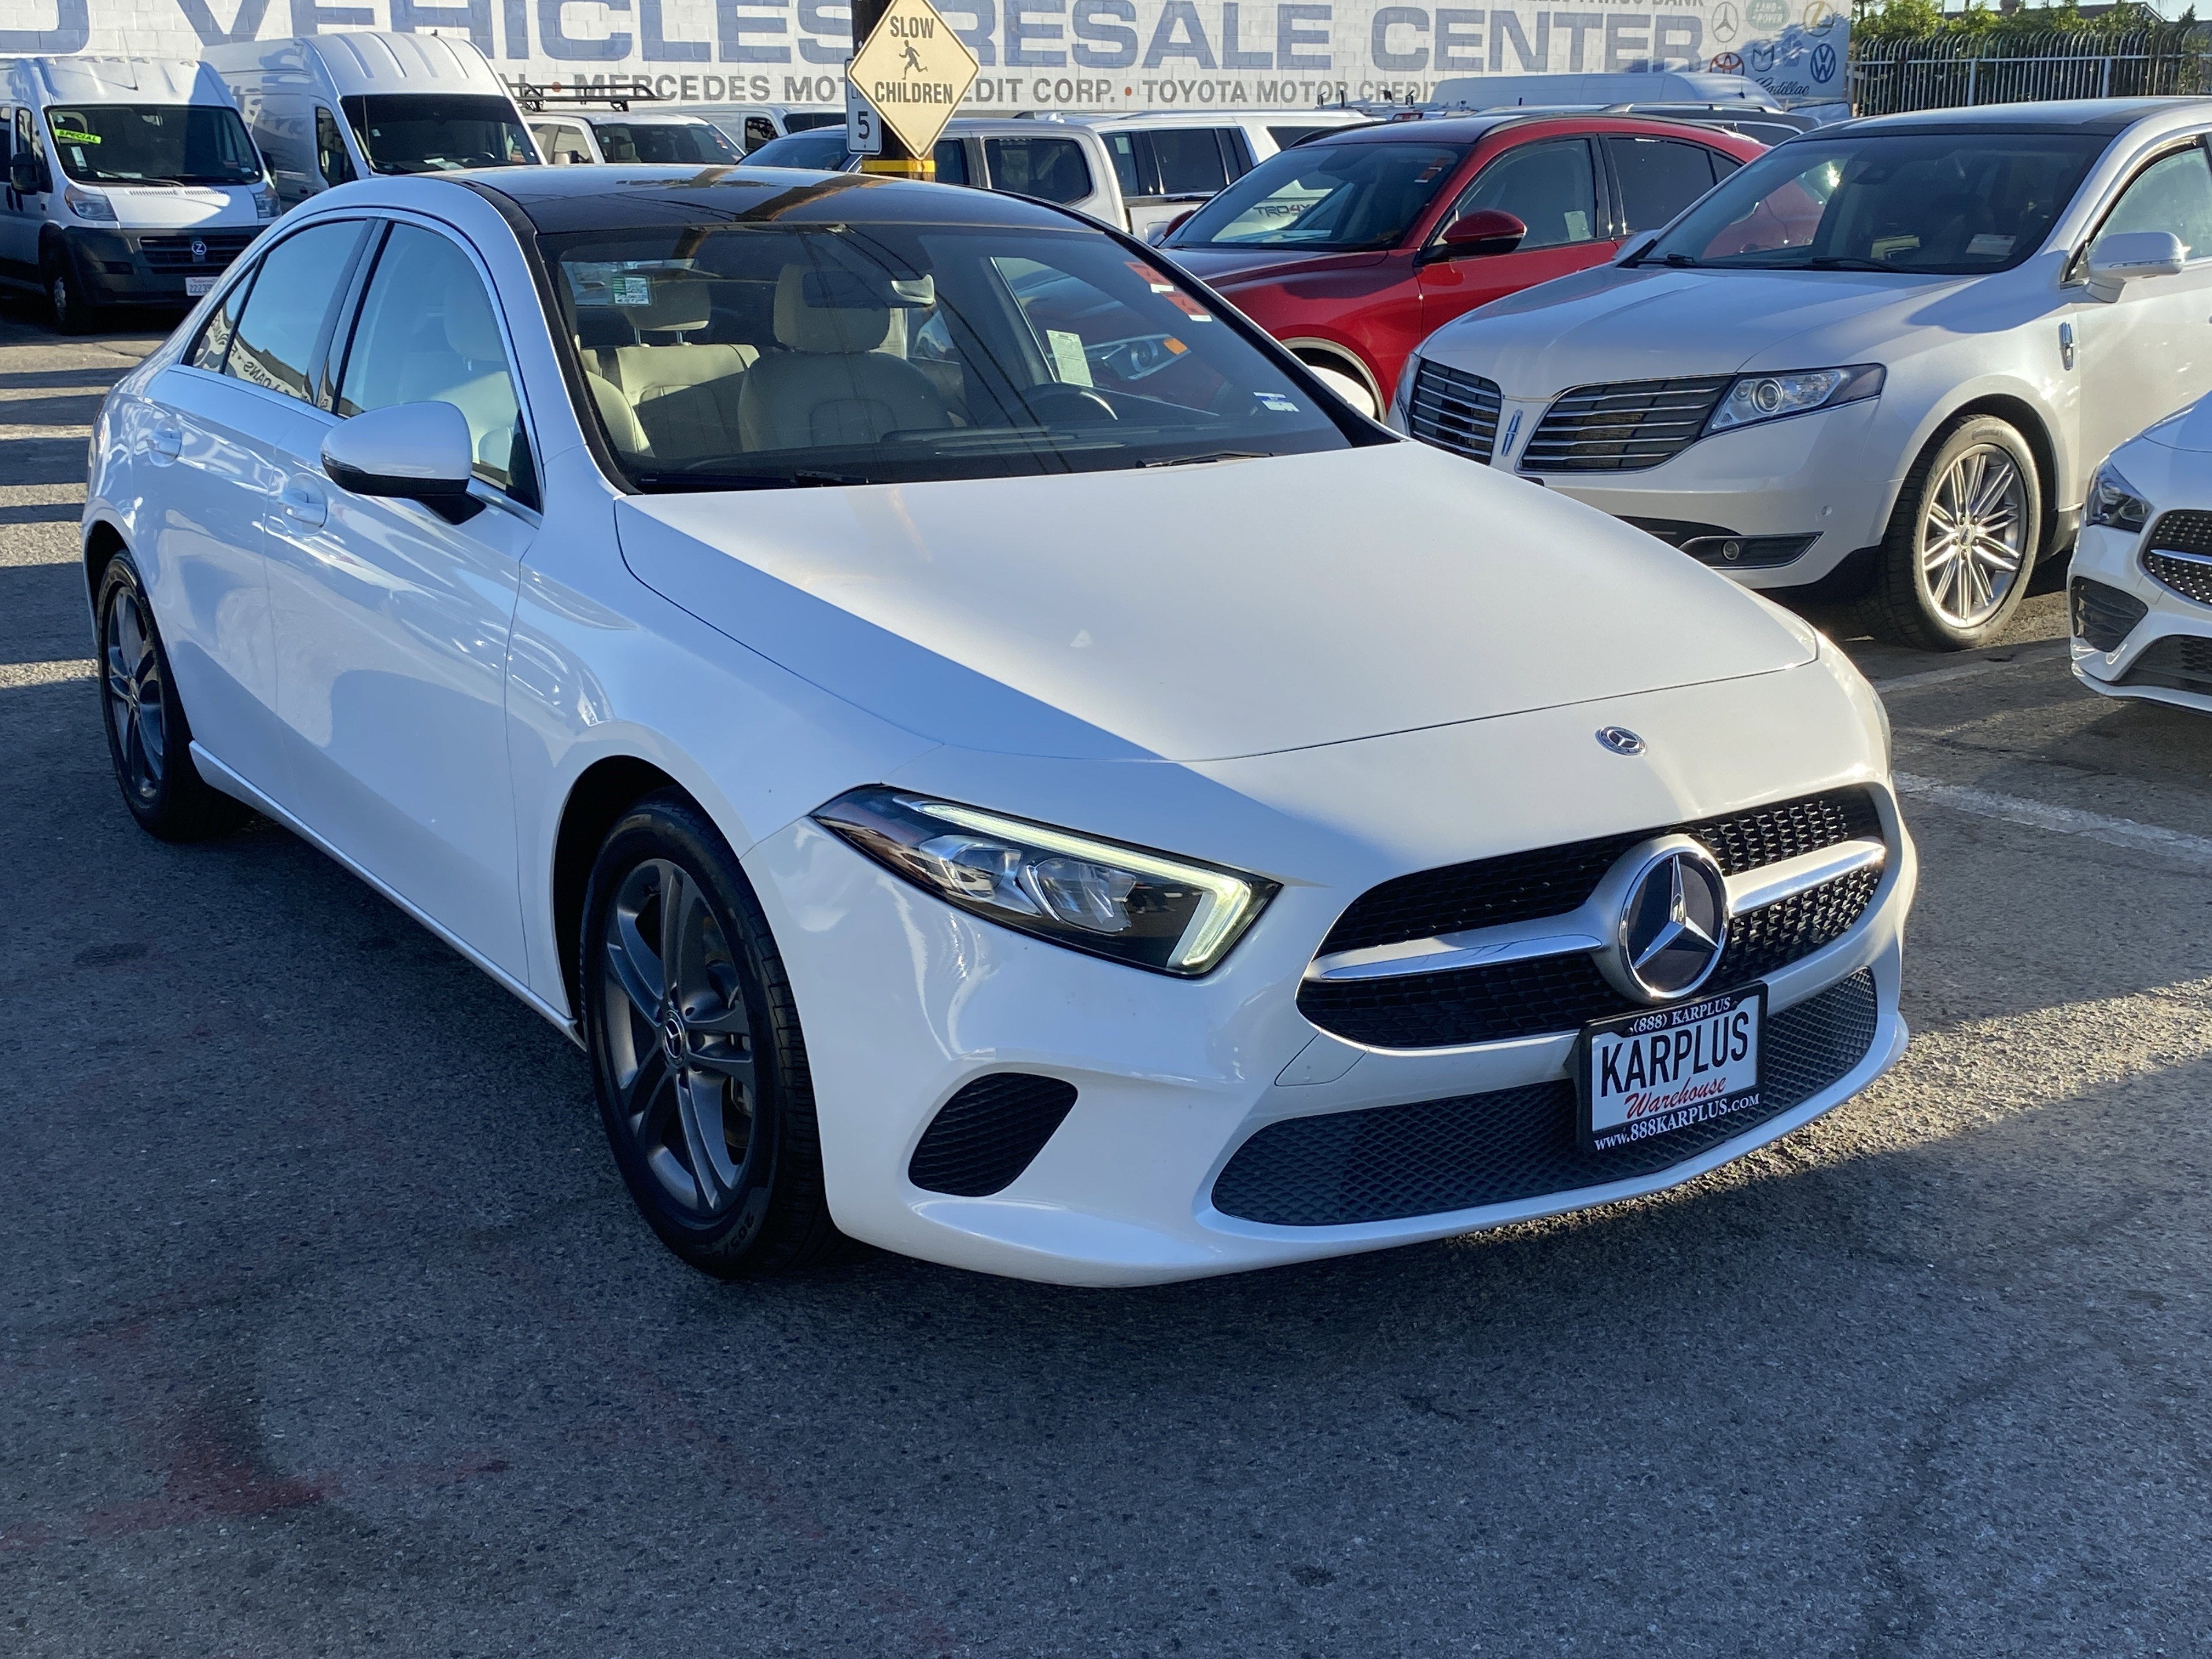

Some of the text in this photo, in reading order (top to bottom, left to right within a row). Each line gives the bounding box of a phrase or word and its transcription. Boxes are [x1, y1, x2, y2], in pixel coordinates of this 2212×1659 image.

[890, 15, 934, 38] SLOW
[932, 0, 1331, 70] RESALE
[1372, 5, 1703, 73] CENTER
[574, 74, 771, 102] MERCEDES
[1032, 78, 1115, 103] CORP.
[1142, 79, 1246, 104] TOYOTA
[1256, 80, 1350, 104] MOTOR
[874, 81, 953, 104] CHILDREN
[857, 111, 870, 139] 5
[1633, 997, 1731, 1034] (888) KARPLUS
[1601, 1011, 1749, 1098] KARPLUS
[1624, 1077, 1726, 1120] Warehouse
